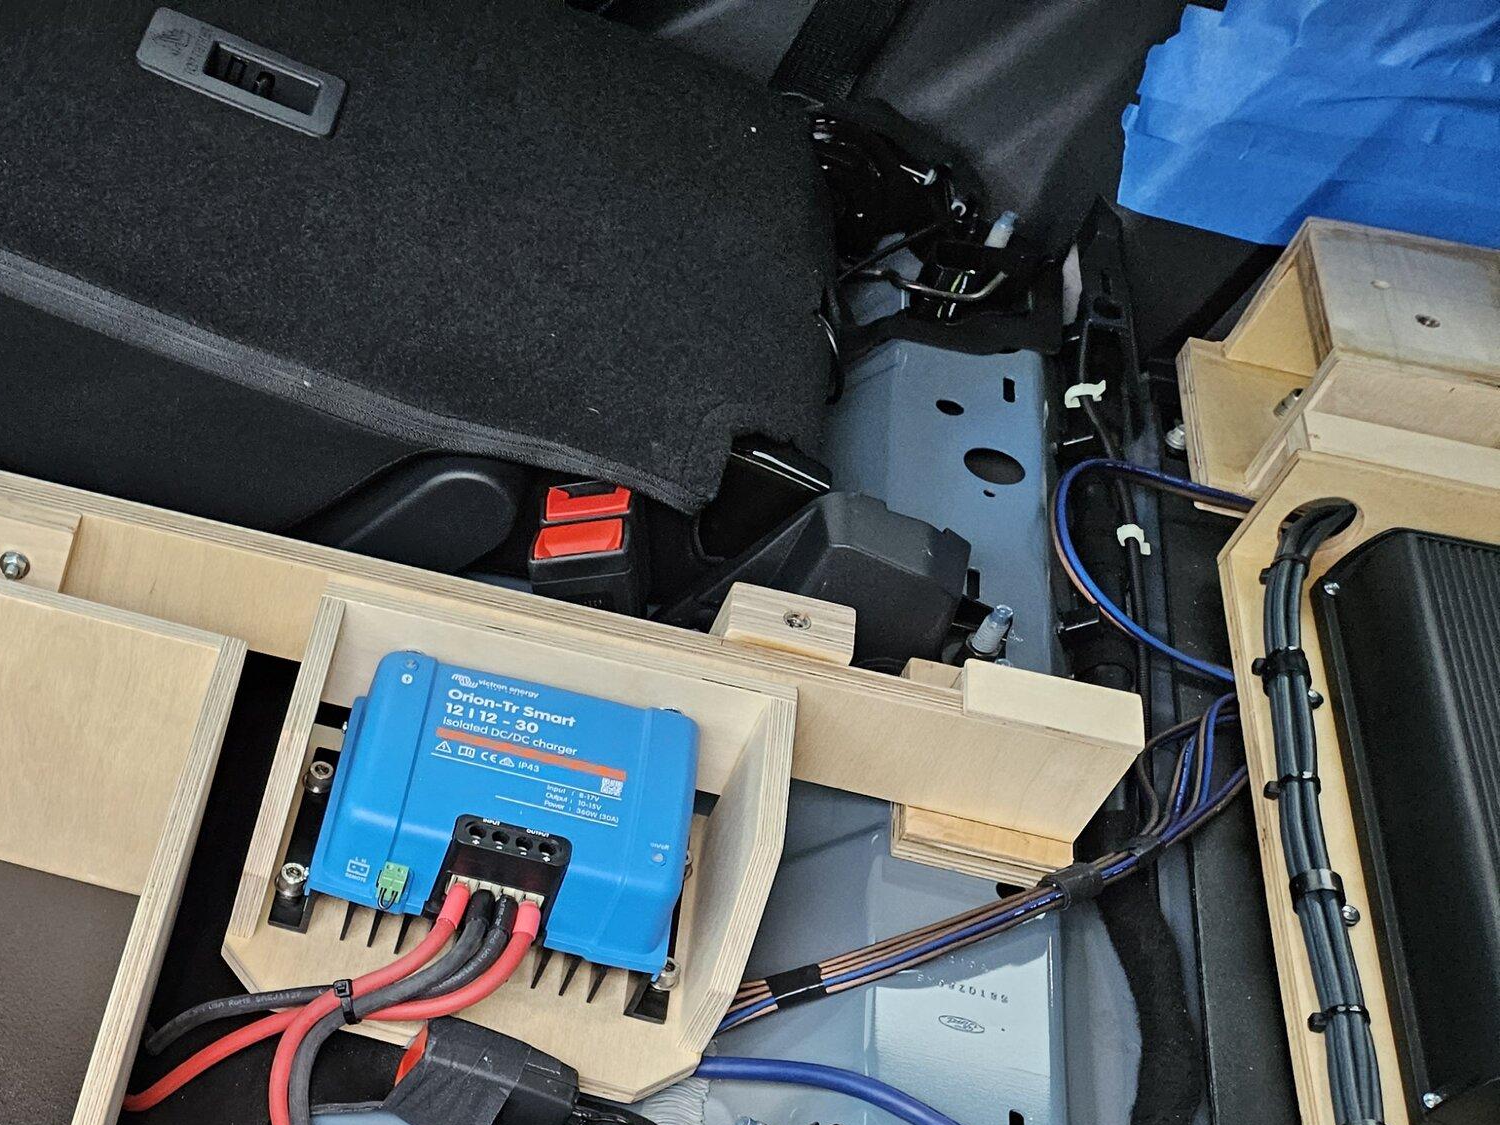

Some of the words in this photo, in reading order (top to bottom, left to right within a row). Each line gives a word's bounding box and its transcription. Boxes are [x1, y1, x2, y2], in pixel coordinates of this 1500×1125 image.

[509, 686, 540, 699] energy
[448, 688, 520, 713] Orion-Tr
[523, 705, 577, 727] Smart
[446, 702, 464, 716] 12
[480, 710, 498, 725] 12
[515, 719, 539, 733] 30
[443, 716, 488, 735] Isolated
[491, 727, 530, 745] DC/DC
[532, 738, 578, 756] charger
[518, 761, 540, 773] IP43
[547, 784, 566, 794] Input
[545, 792, 568, 803] Output
[544, 800, 566, 811] Power
[526, 828, 550, 838] OUTPUT
